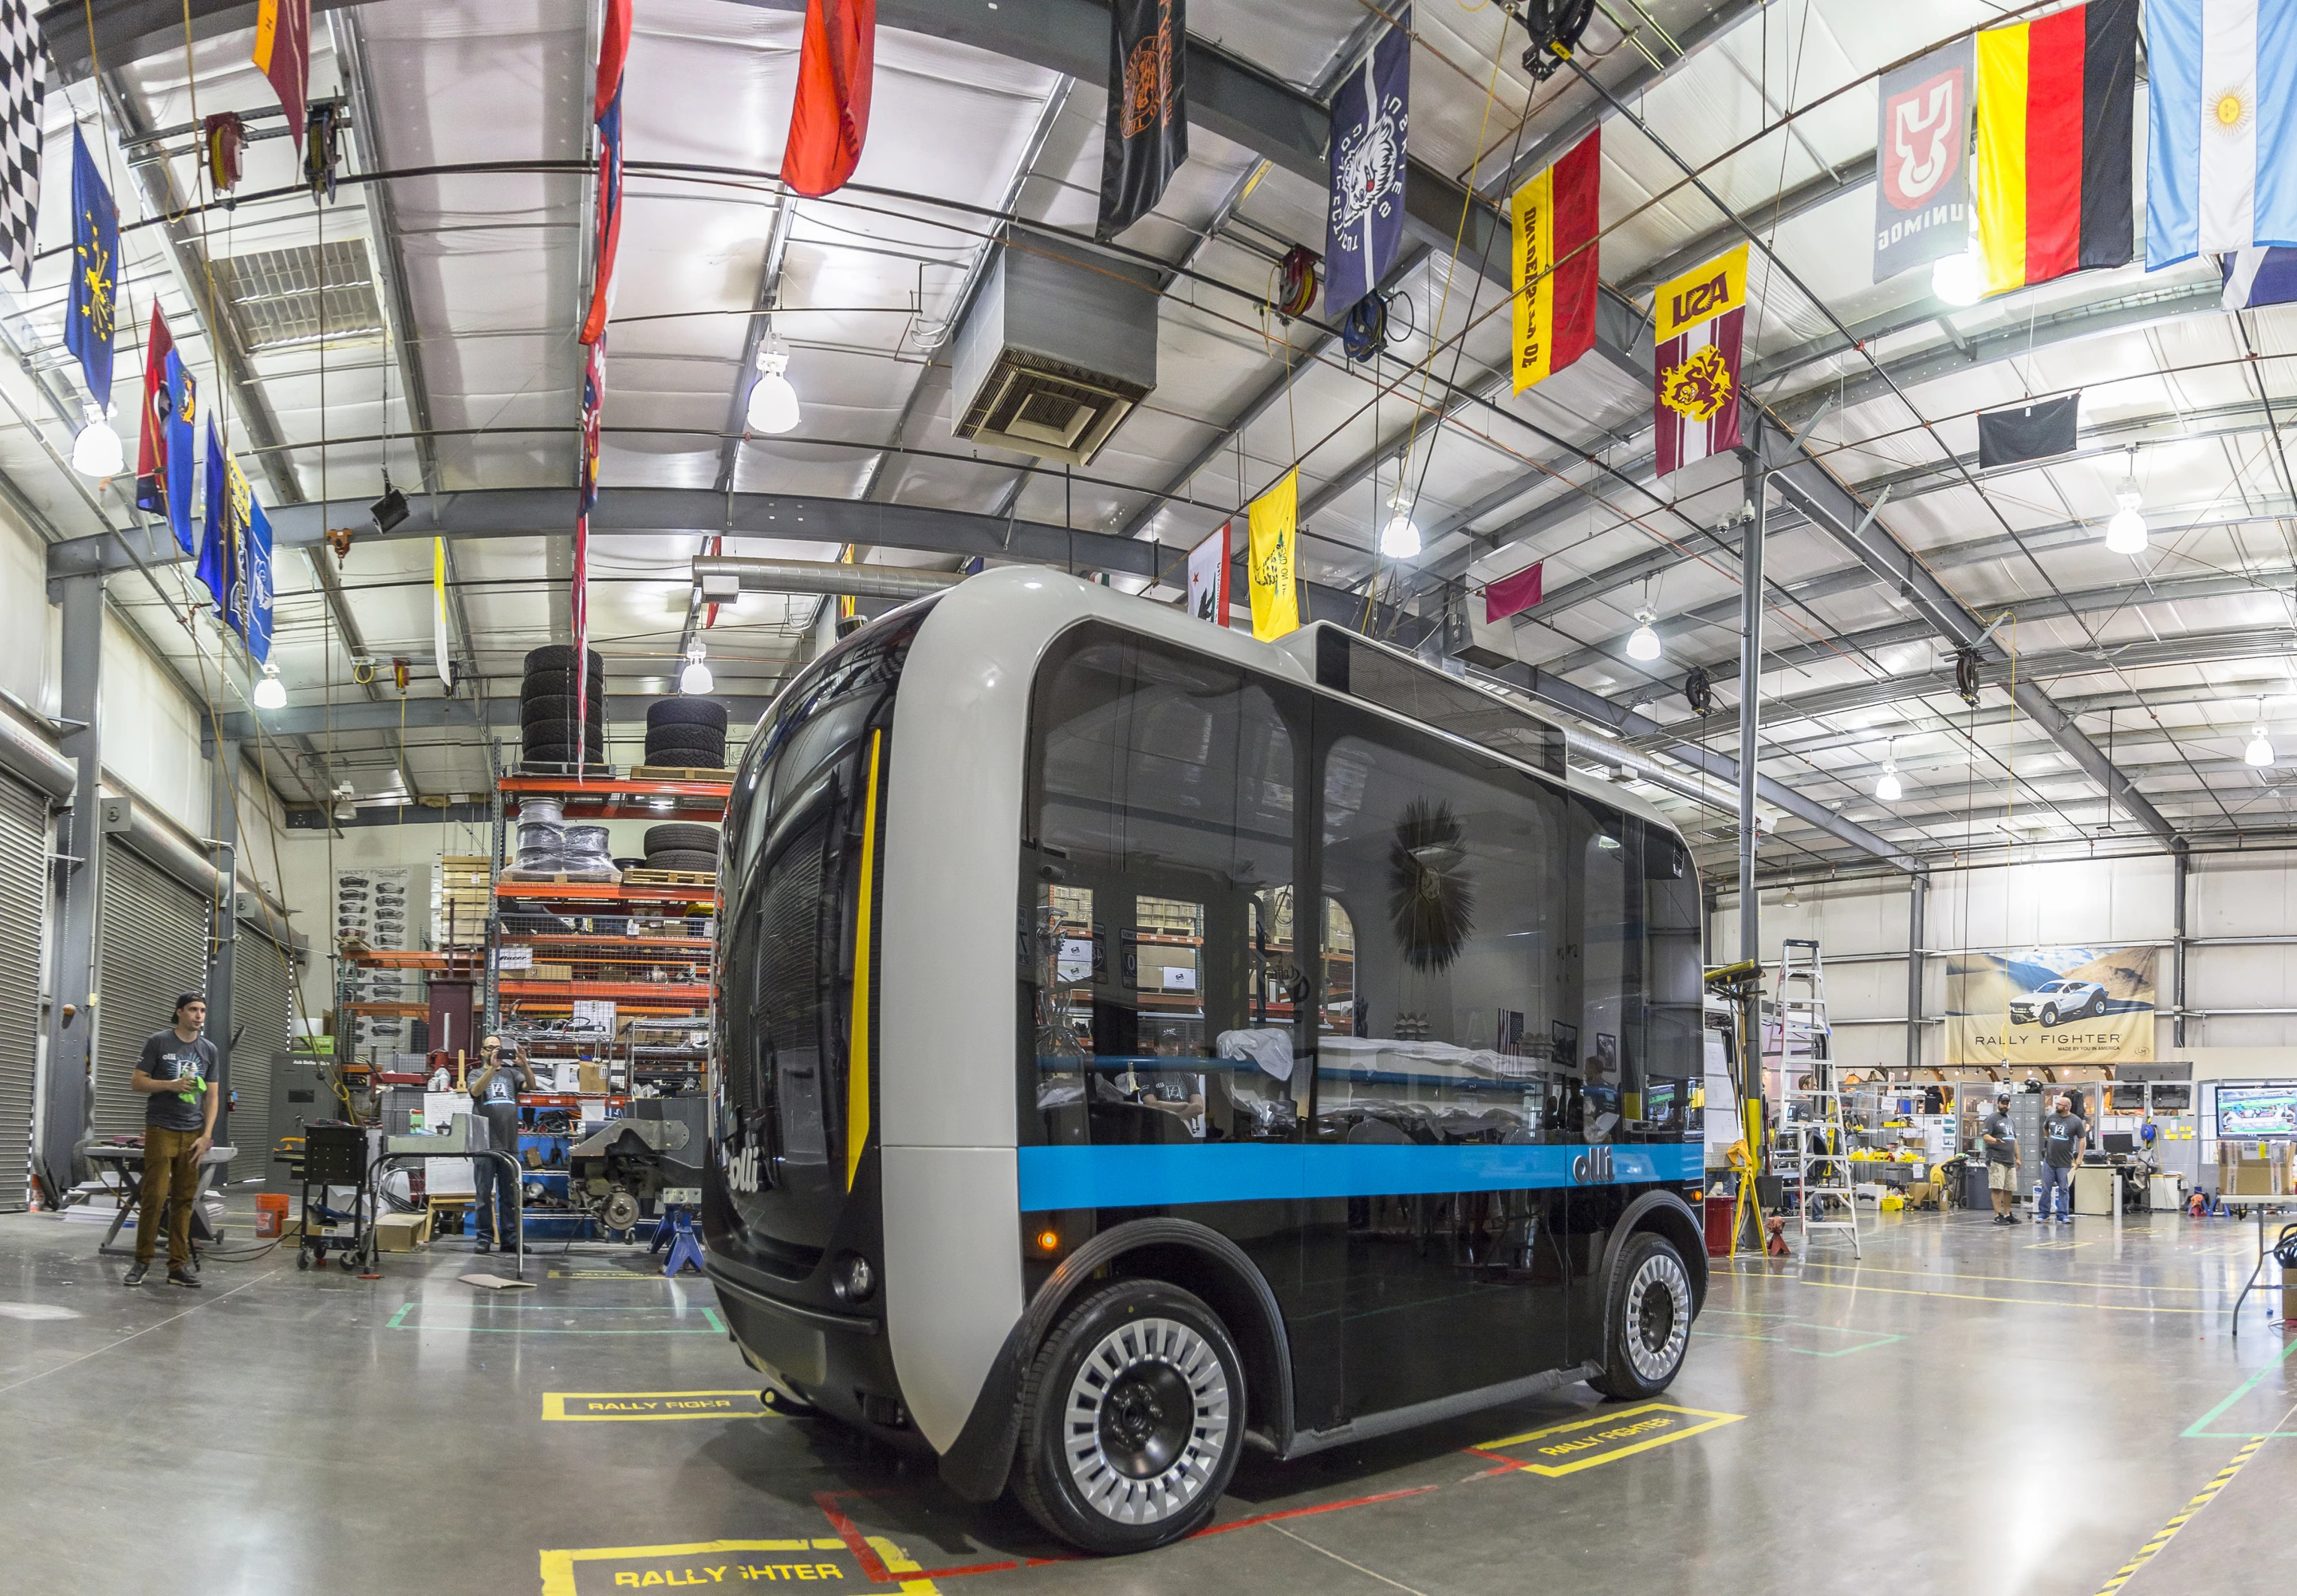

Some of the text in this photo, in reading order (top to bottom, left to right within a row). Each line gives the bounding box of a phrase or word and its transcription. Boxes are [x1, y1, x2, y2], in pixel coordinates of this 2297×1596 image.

[1975, 1034, 2121, 1045] RALLY FIGHTER
[729, 1146, 758, 1193] olli
[1573, 1145, 1615, 1184] olli
[1538, 1417, 1675, 1456] RALLY FIGHTER
[614, 1566, 727, 1588] RALLY
